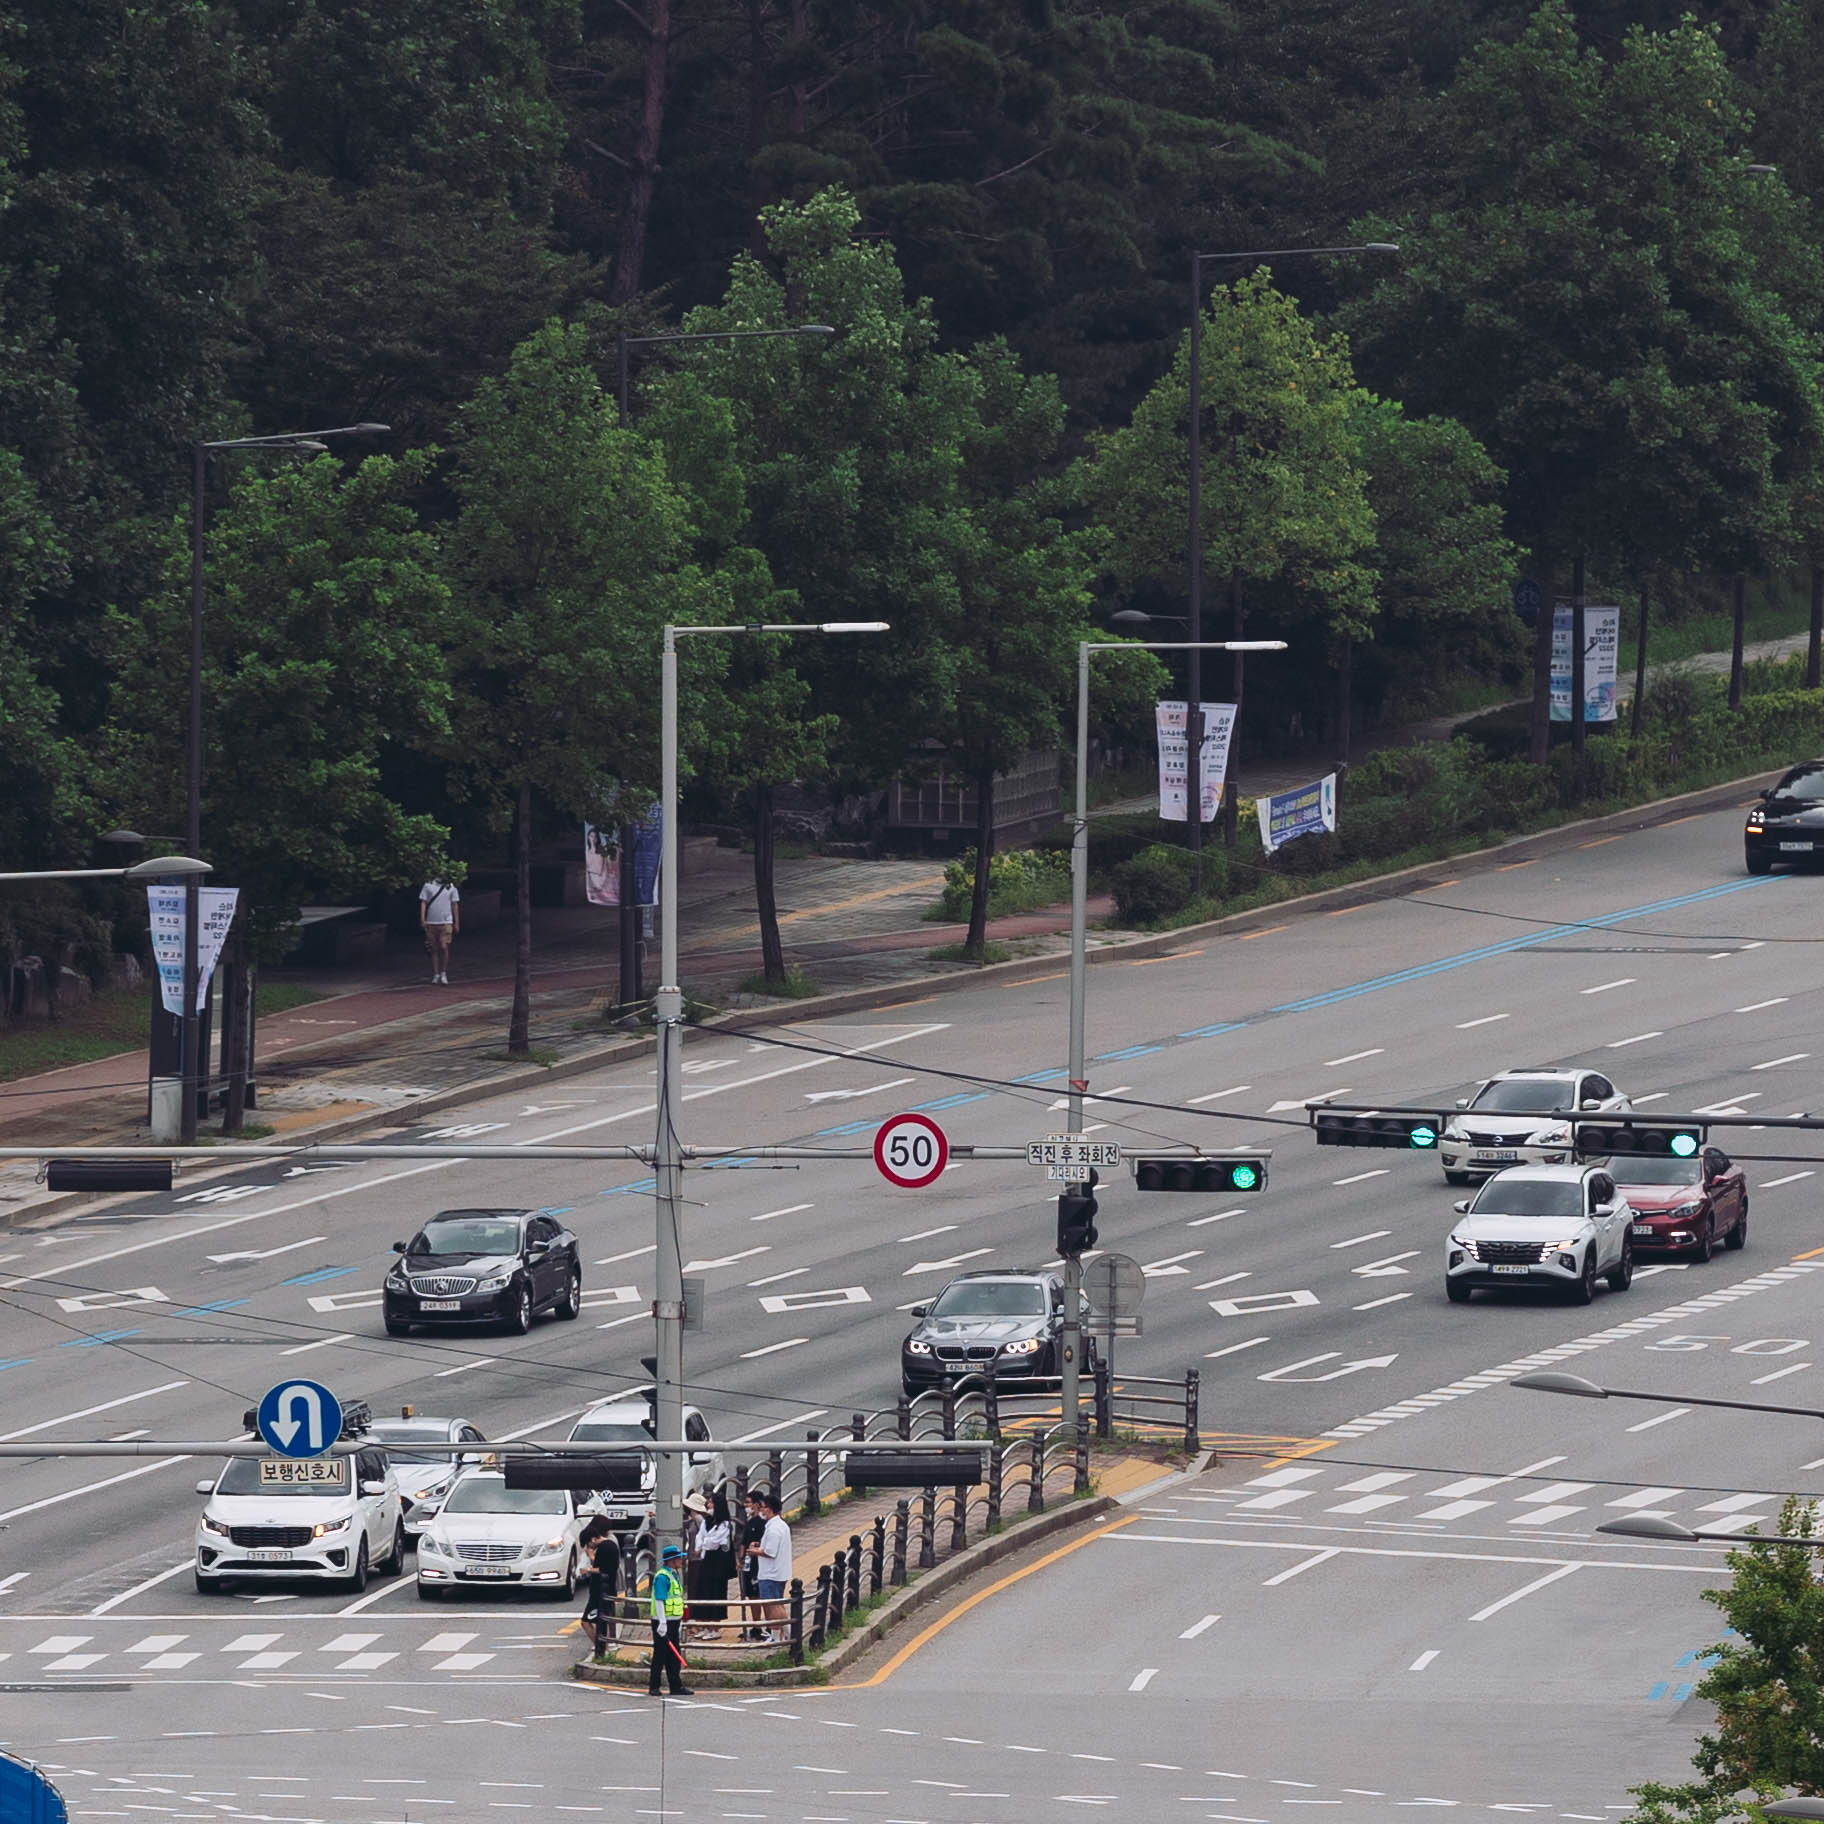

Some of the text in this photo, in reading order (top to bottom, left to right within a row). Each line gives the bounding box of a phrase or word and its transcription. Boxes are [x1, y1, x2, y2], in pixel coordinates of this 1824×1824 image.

[889, 1135, 932, 1167] 50
[1029, 1145, 1118, 1165] 직진 후 좌회전
[262, 1460, 343, 1484] 보행신호시
